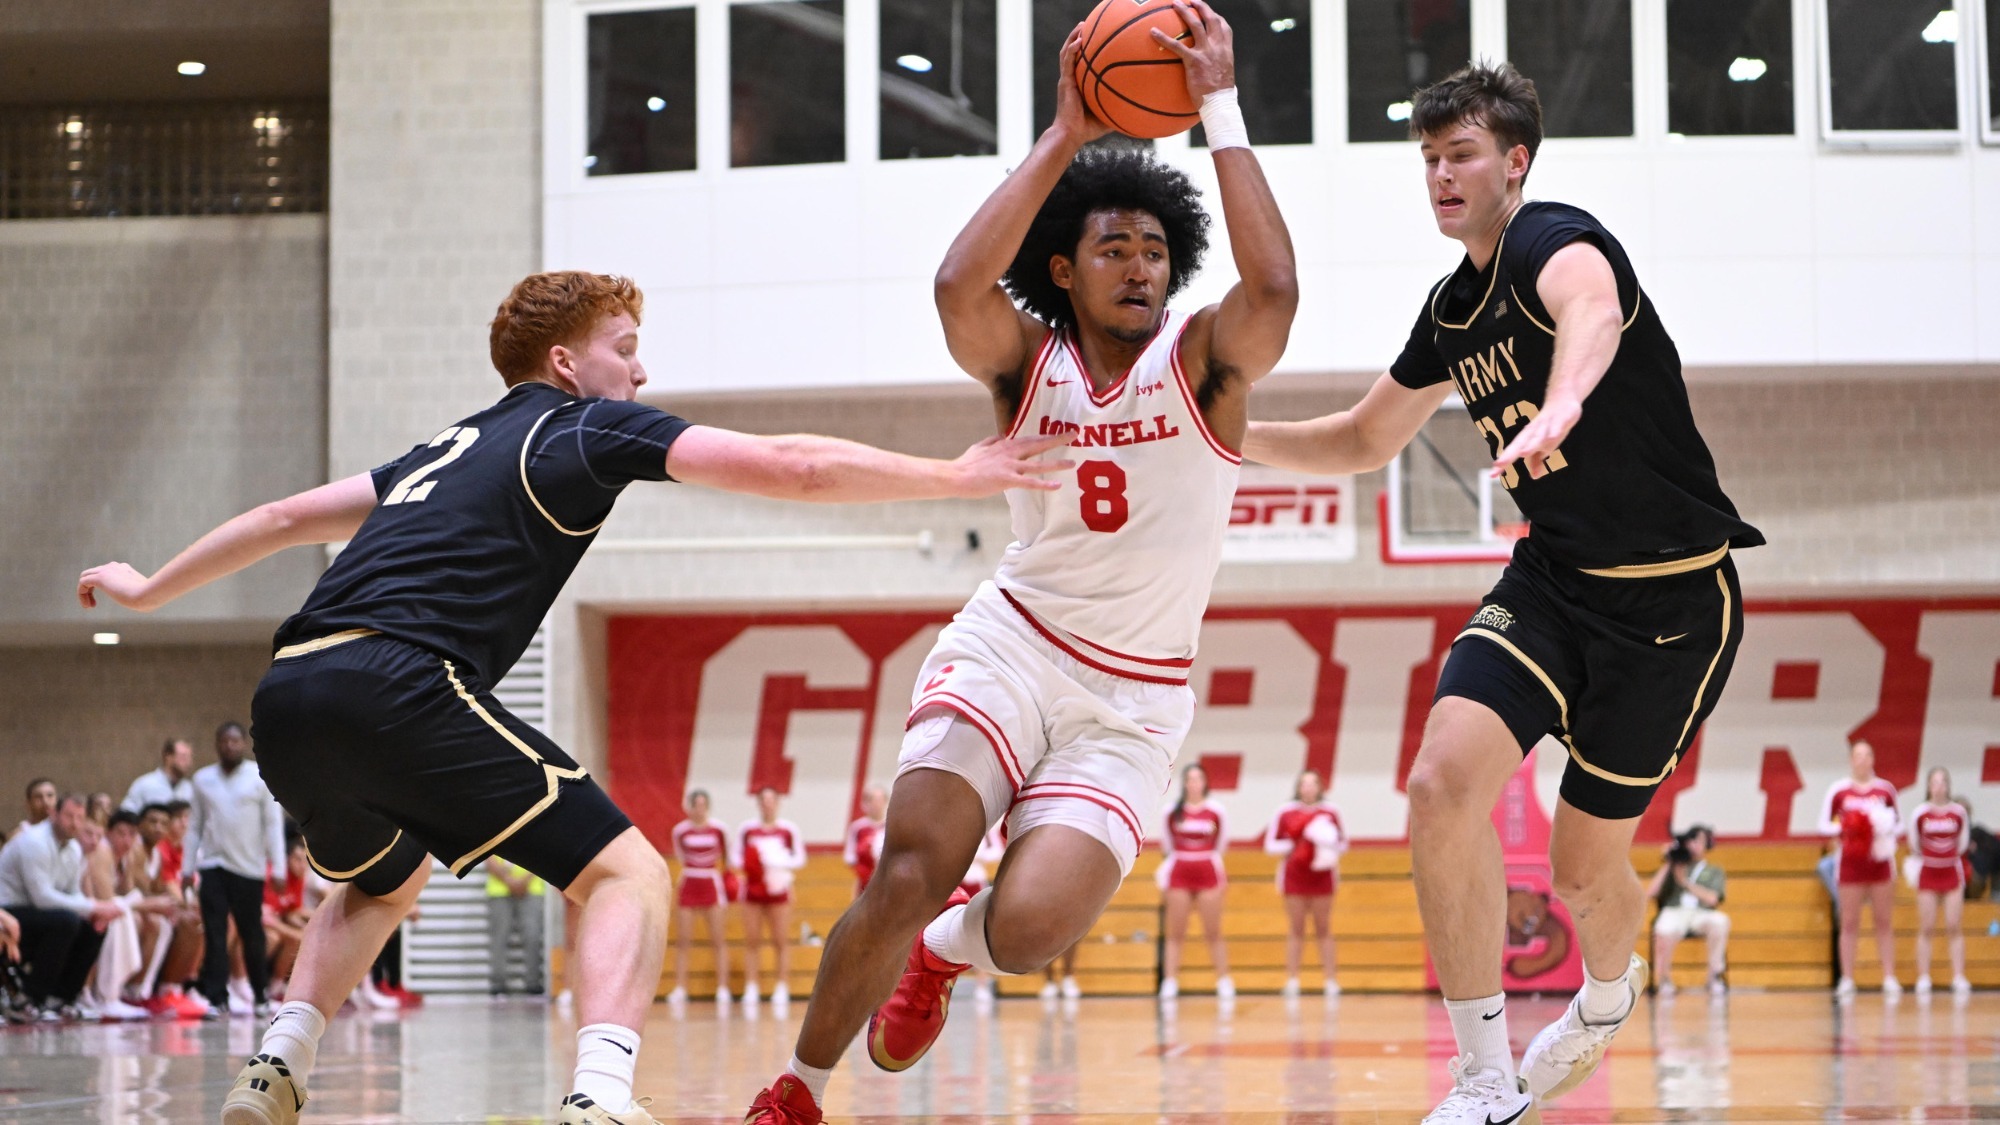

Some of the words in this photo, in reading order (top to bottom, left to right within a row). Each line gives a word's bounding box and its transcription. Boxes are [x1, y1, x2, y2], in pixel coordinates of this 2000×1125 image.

[1136, 384, 1154, 397] Ivy
[382, 426, 480, 506] 2
[1475, 400, 1568, 489] 32
[1077, 459, 1129, 533] 8
[1228, 486, 1340, 525] SPN
[681, 623, 945, 845] G
[1162, 617, 1453, 838] BI
